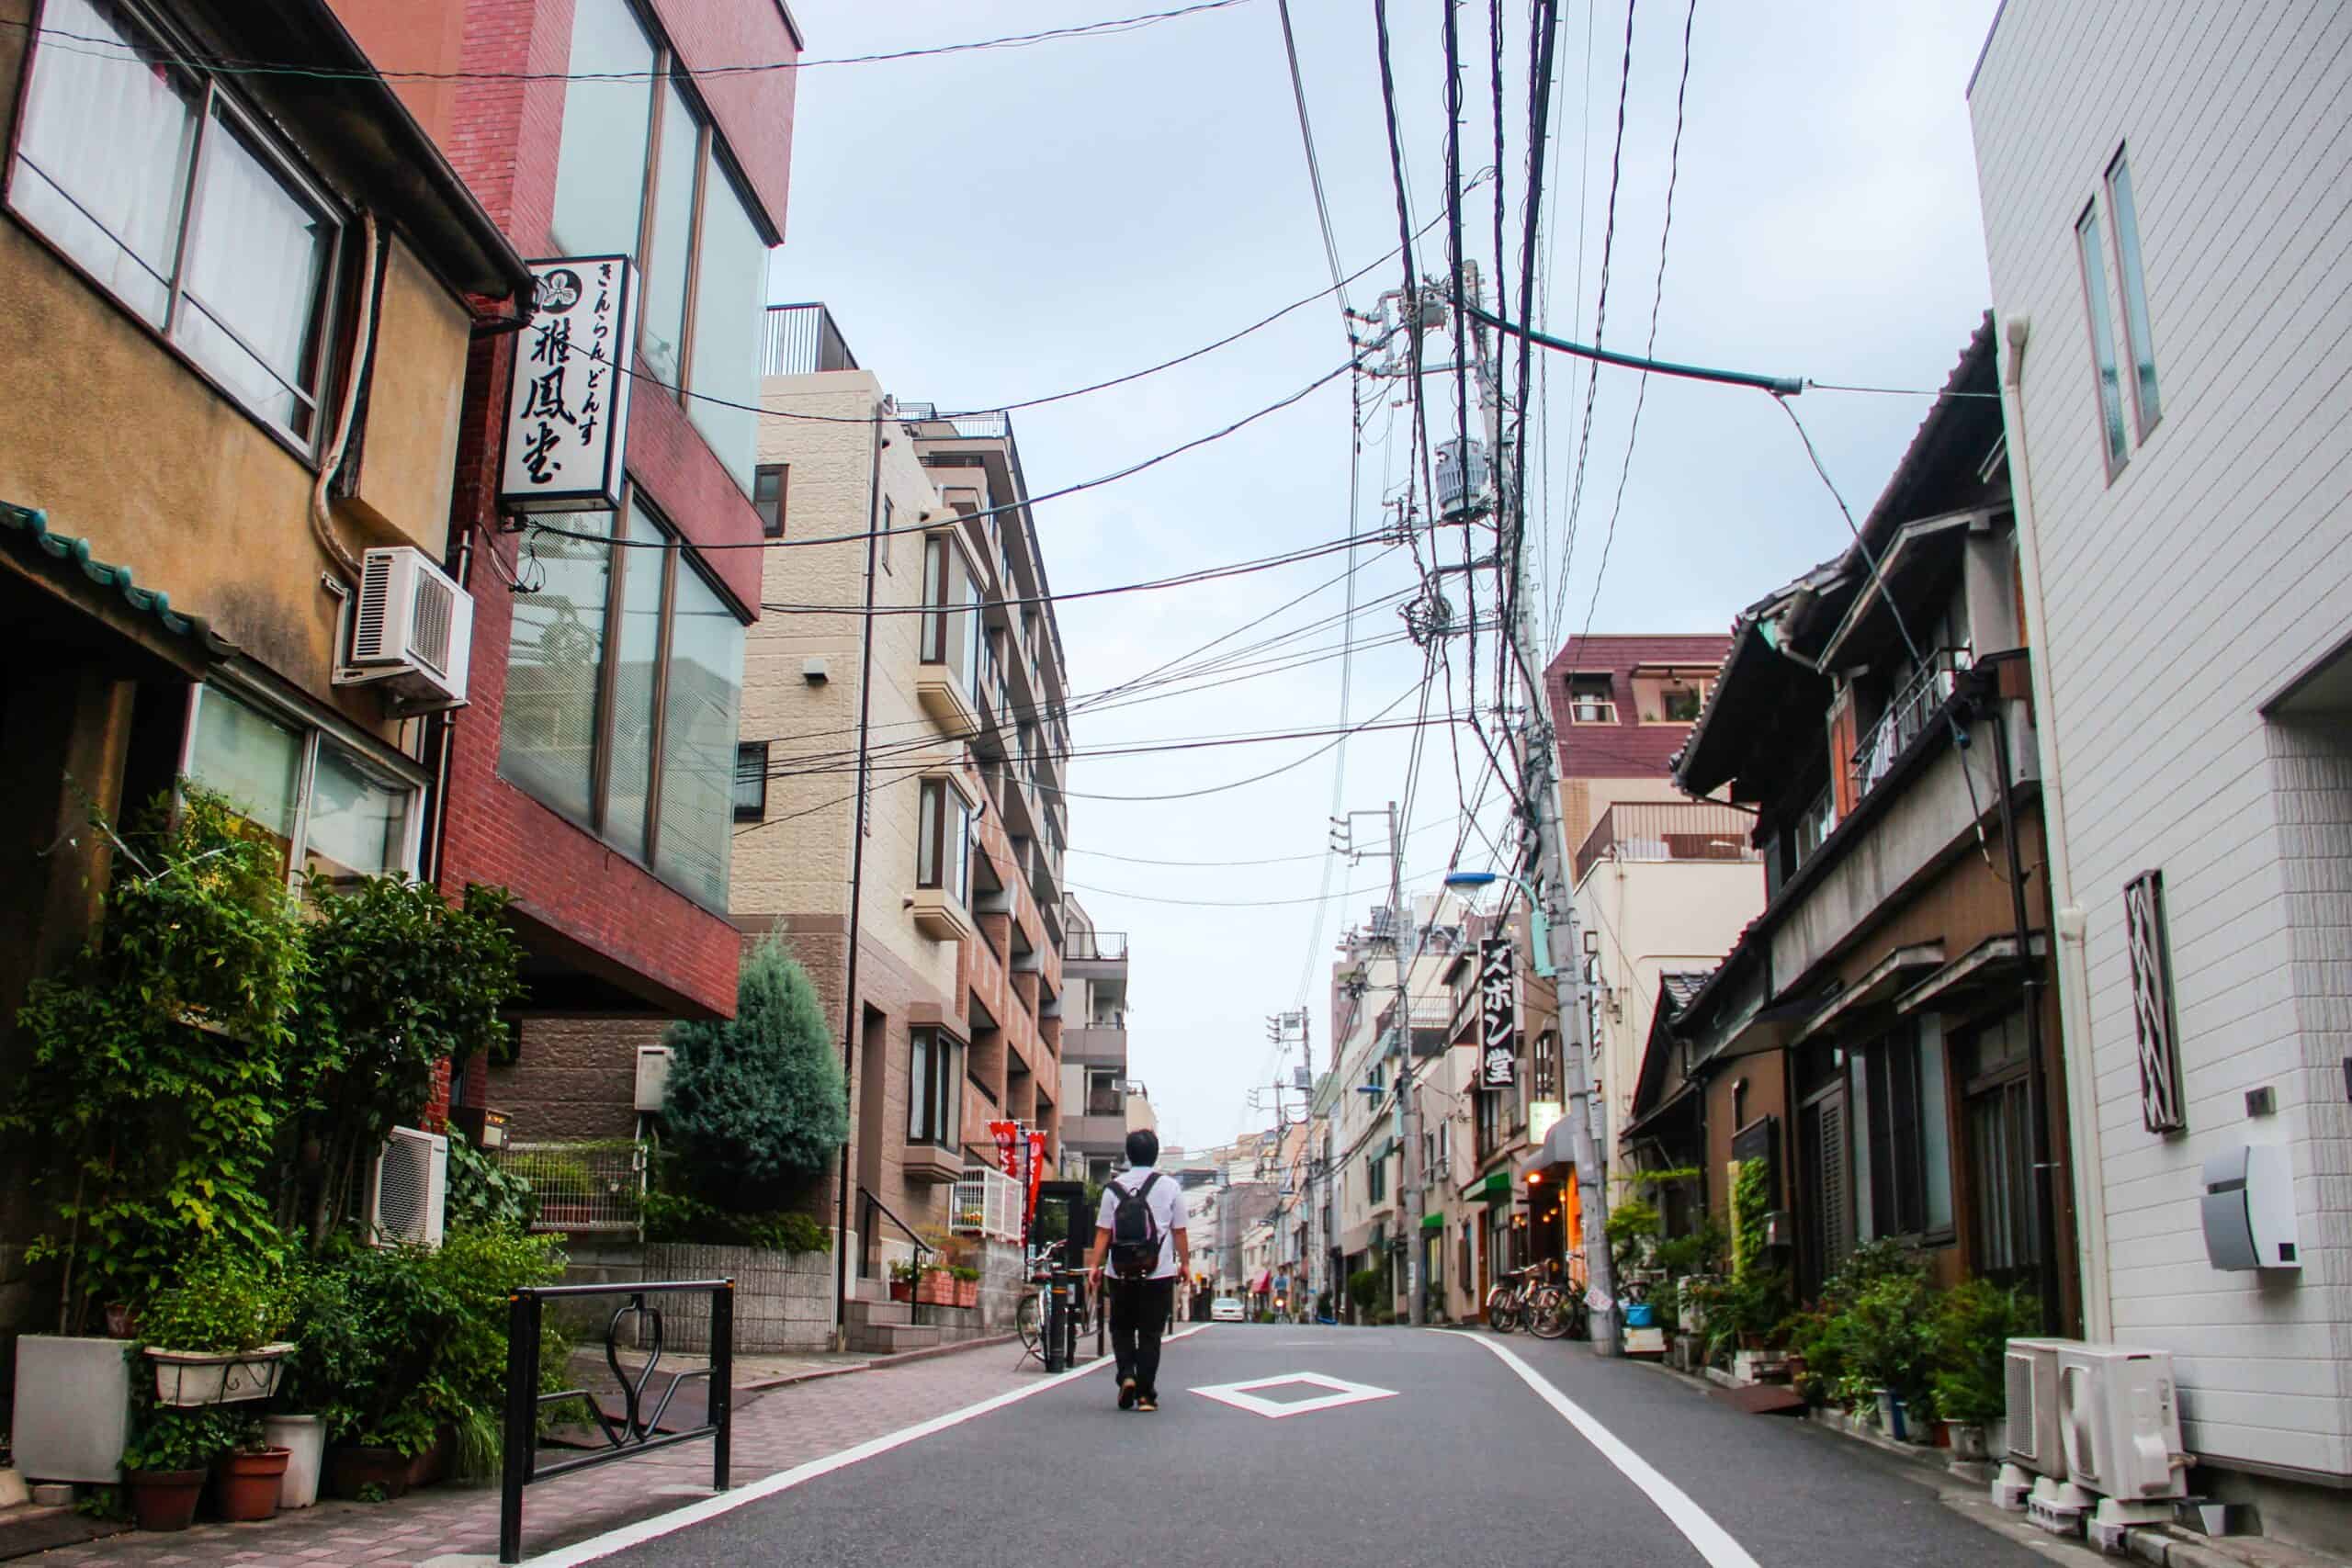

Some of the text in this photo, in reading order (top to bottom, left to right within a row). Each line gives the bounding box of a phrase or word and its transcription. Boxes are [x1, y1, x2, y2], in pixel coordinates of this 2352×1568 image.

[578, 263, 613, 446] きんらんどんす
